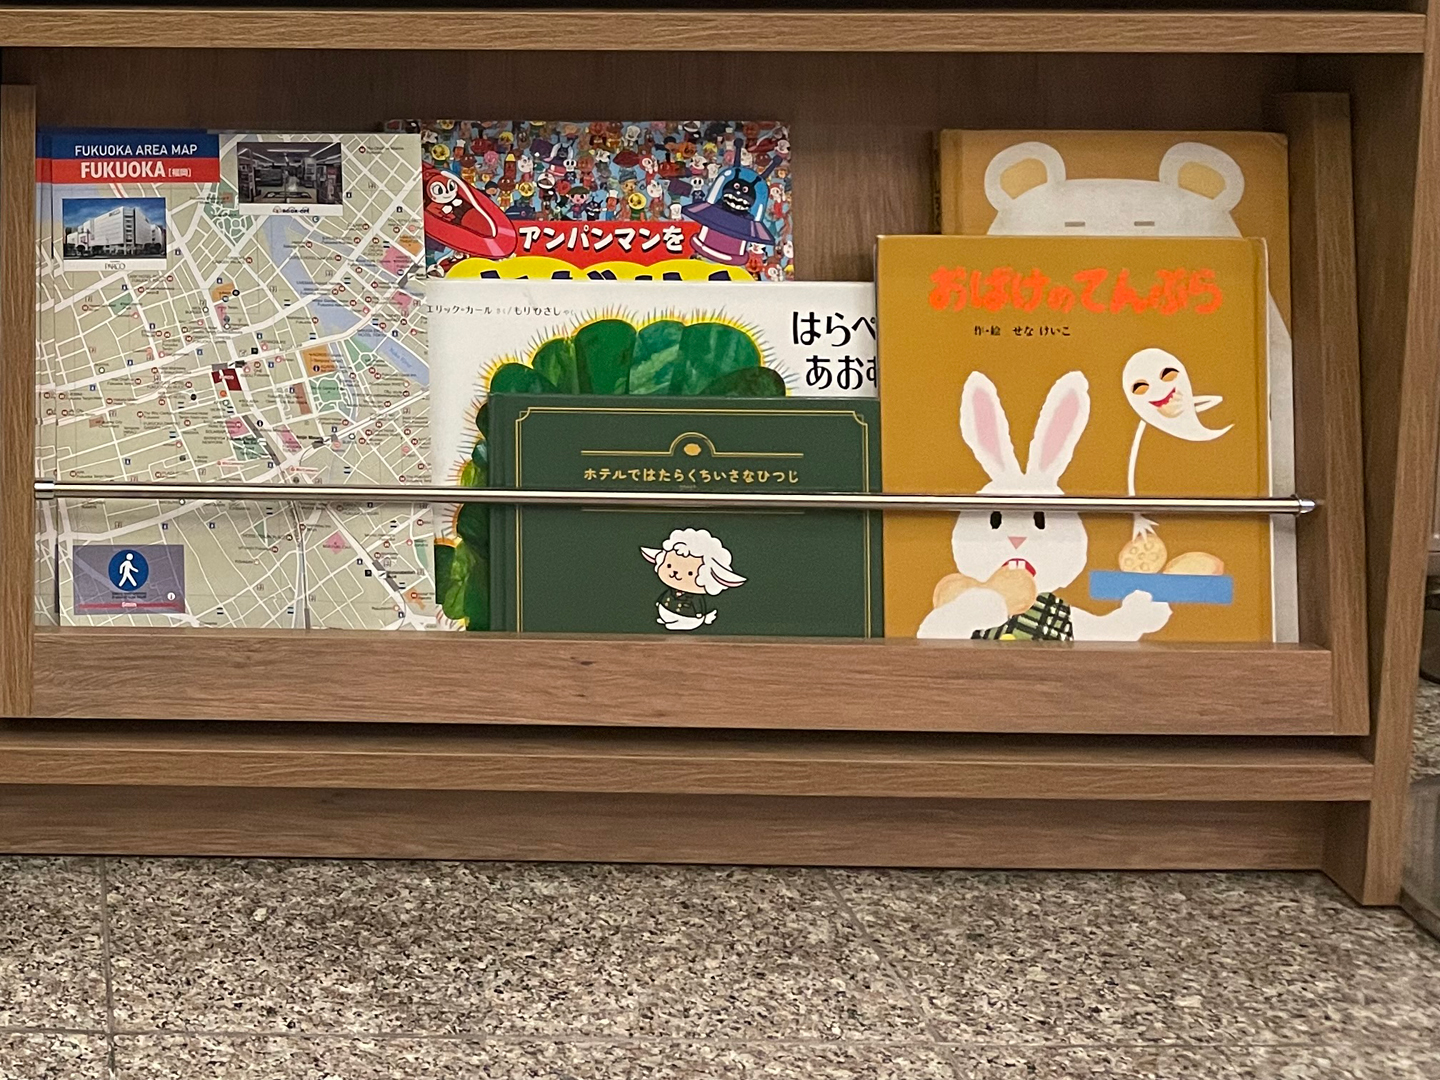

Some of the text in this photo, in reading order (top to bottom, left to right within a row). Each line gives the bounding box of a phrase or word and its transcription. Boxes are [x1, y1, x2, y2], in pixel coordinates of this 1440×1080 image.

[74, 144, 198, 157] FUKUOKA AREA MAP
[80, 160, 166, 179] FUKUOKA
[518, 224, 686, 253] アンパンマンを
[928, 266, 1224, 316] おばけのてんぷら
[513, 305, 561, 317] もりひさし
[973, 325, 1072, 337] 作・絵 せな けいこ
[583, 467, 801, 485] ホテルではたらくちいさなひつじ
